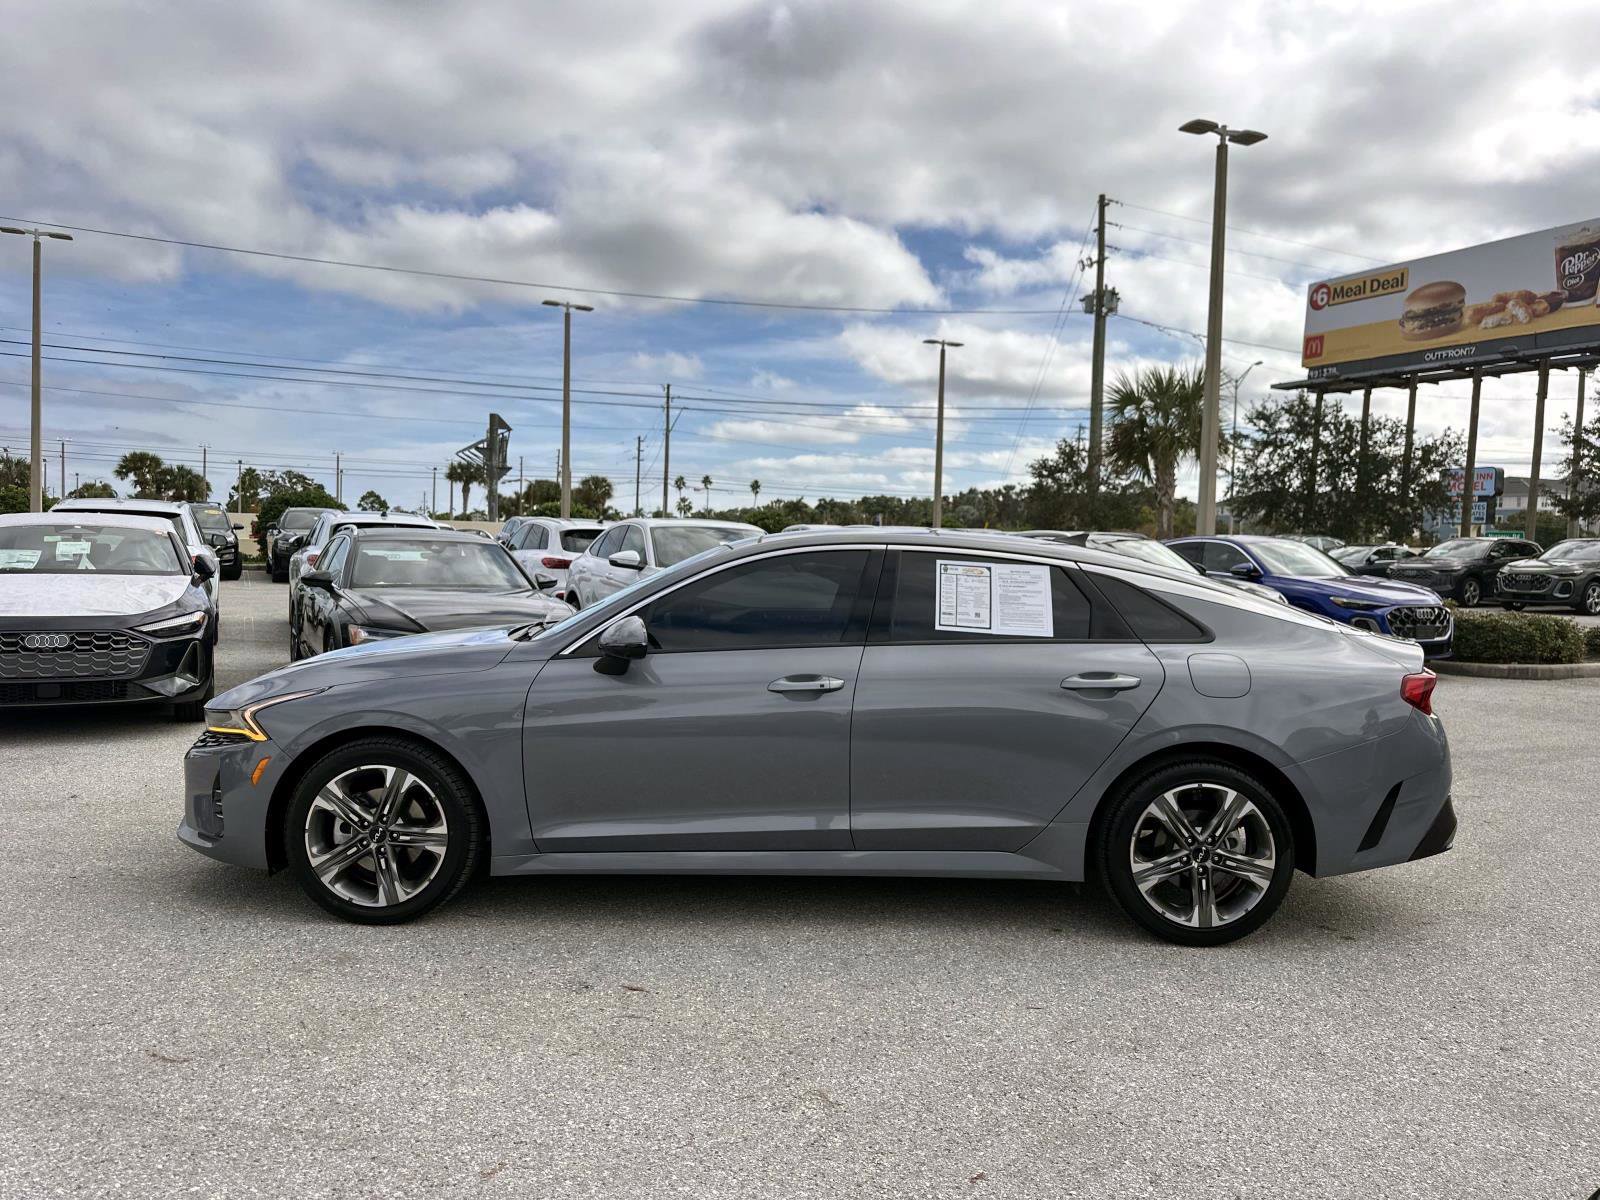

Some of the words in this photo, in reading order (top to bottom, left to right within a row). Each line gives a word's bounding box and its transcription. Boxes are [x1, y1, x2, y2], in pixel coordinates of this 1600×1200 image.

[1562, 252, 1598, 276] Pepper
[1574, 251, 1589, 264] Dr
[1332, 280, 1366, 301] Meal
[1370, 271, 1405, 293] Deal
[1476, 472, 1494, 480] INN
[1449, 481, 1486, 492] MOEL
